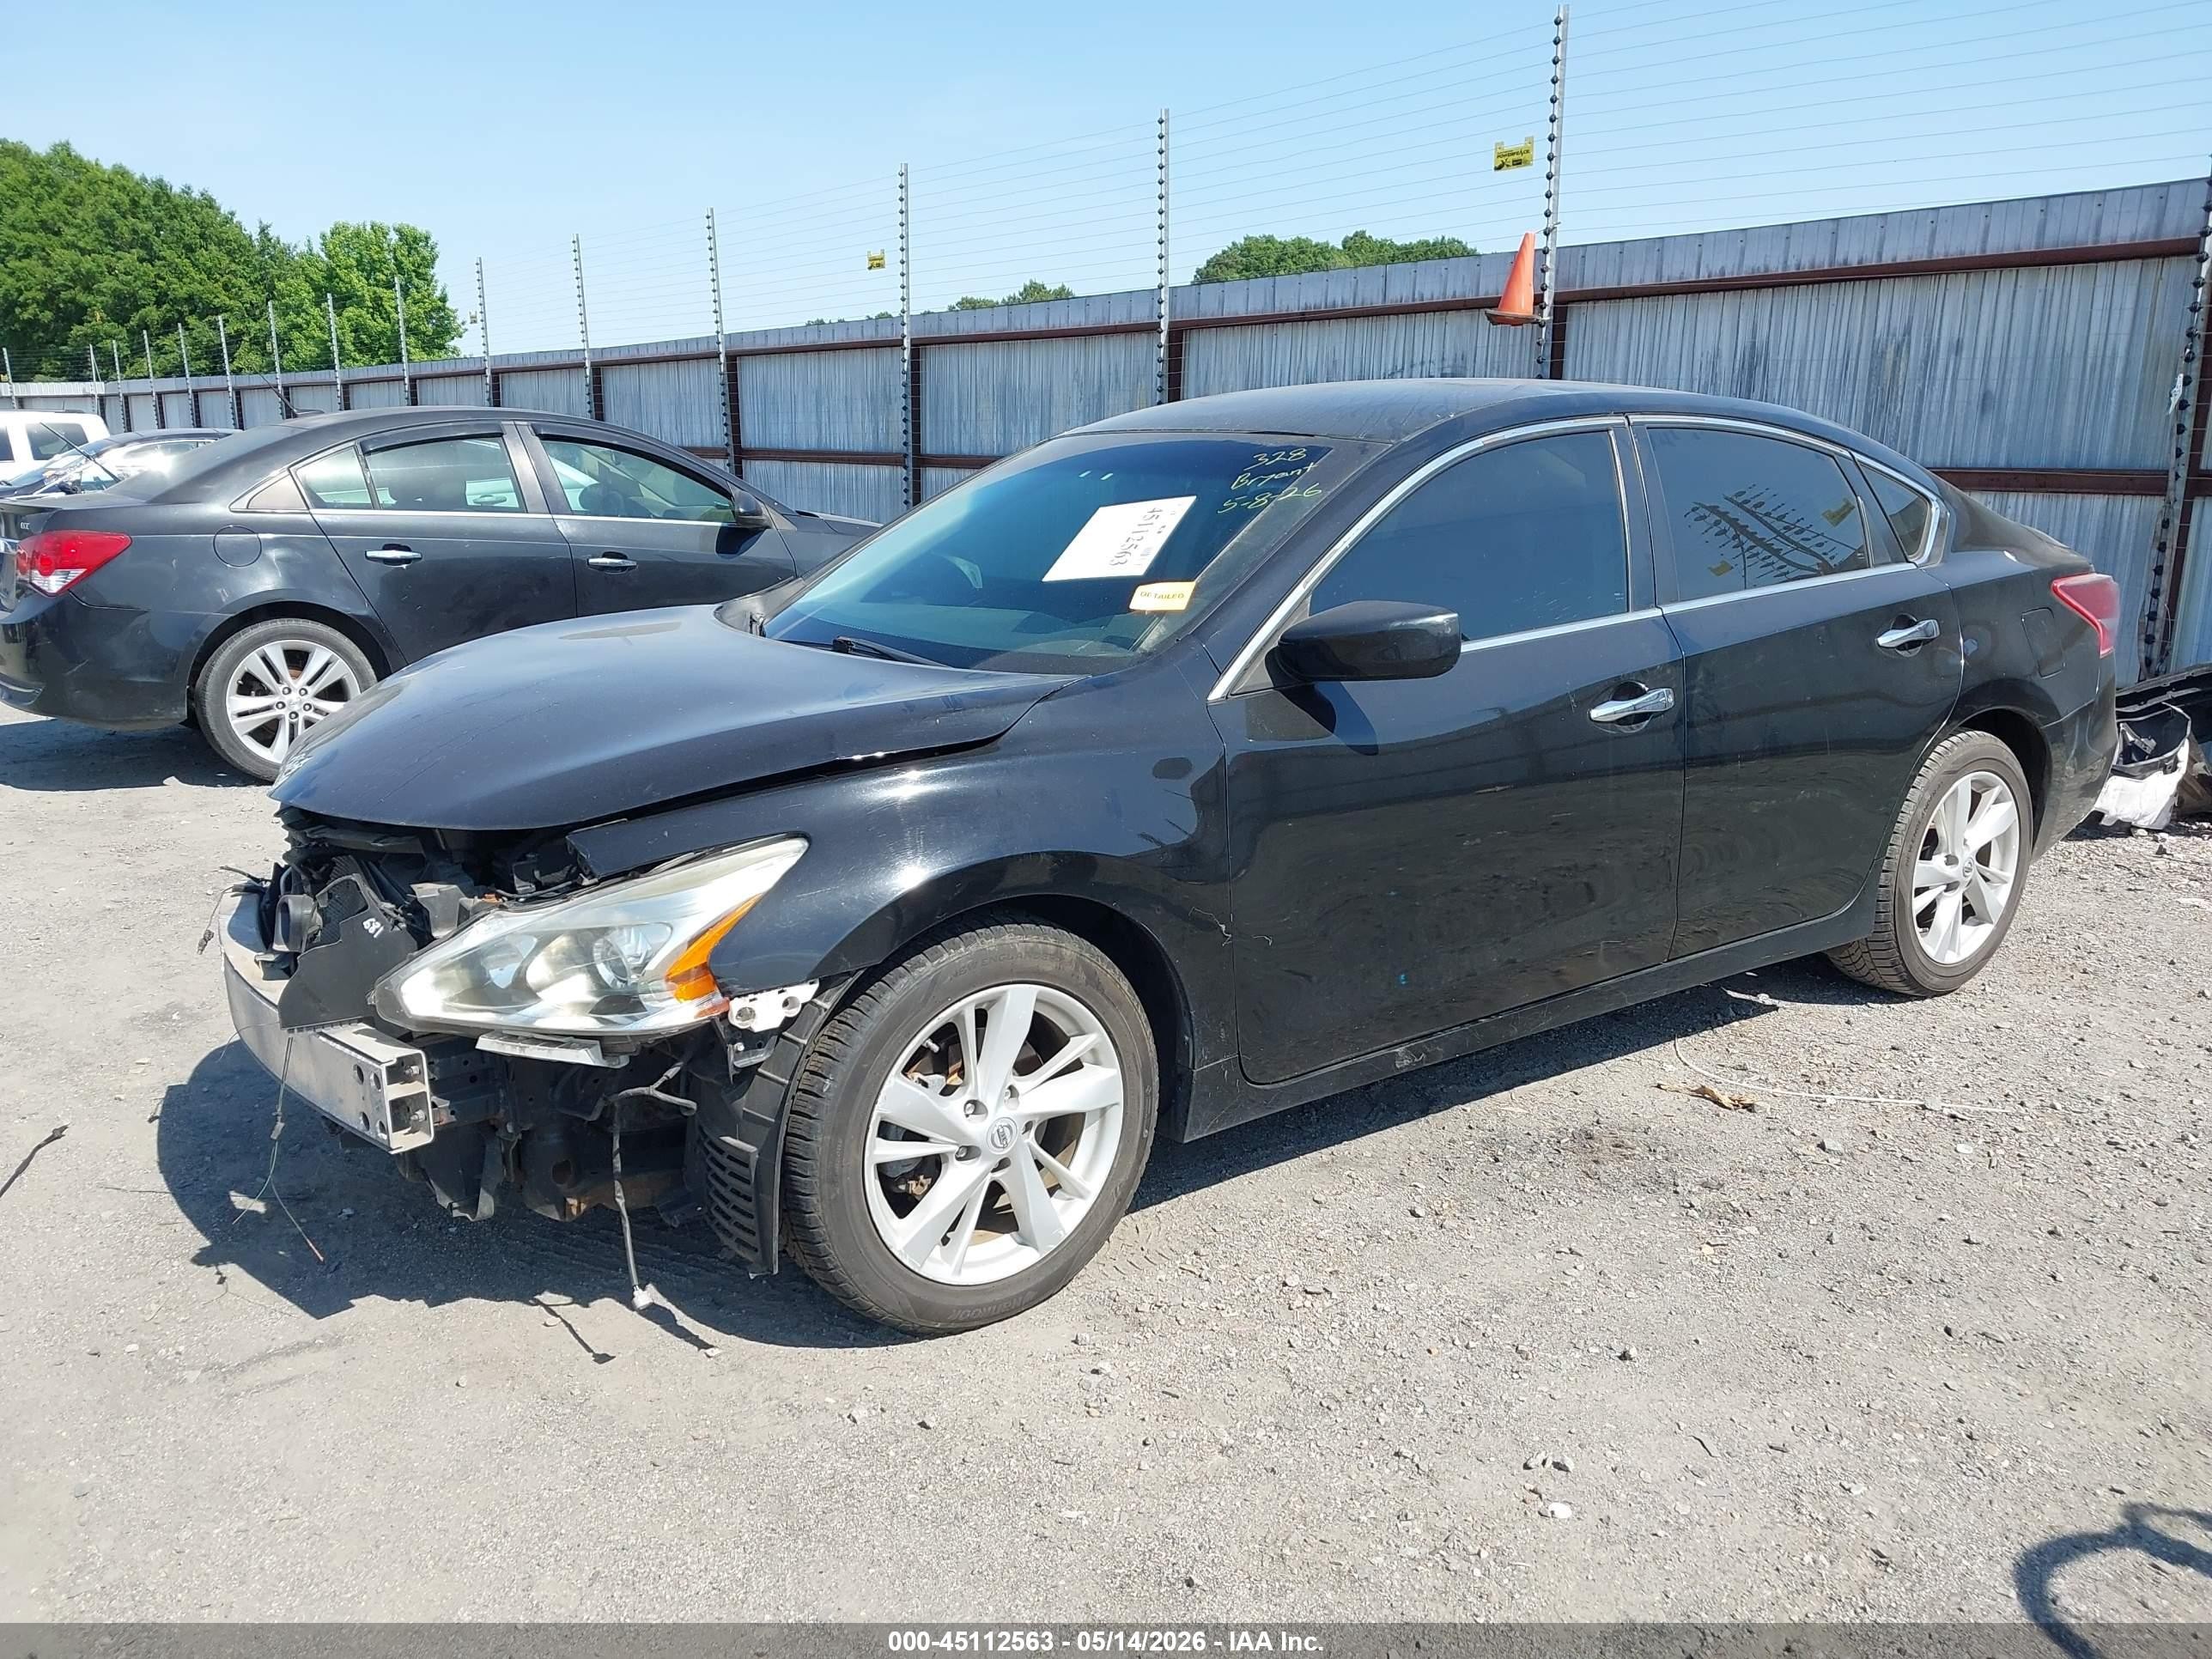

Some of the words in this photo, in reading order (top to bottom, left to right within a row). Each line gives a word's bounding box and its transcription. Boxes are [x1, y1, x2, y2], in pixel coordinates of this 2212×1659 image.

[1243, 447, 1308, 471] 328
[1230, 461, 1318, 490] Bryant
[1217, 482, 1322, 514] 5-8-26
